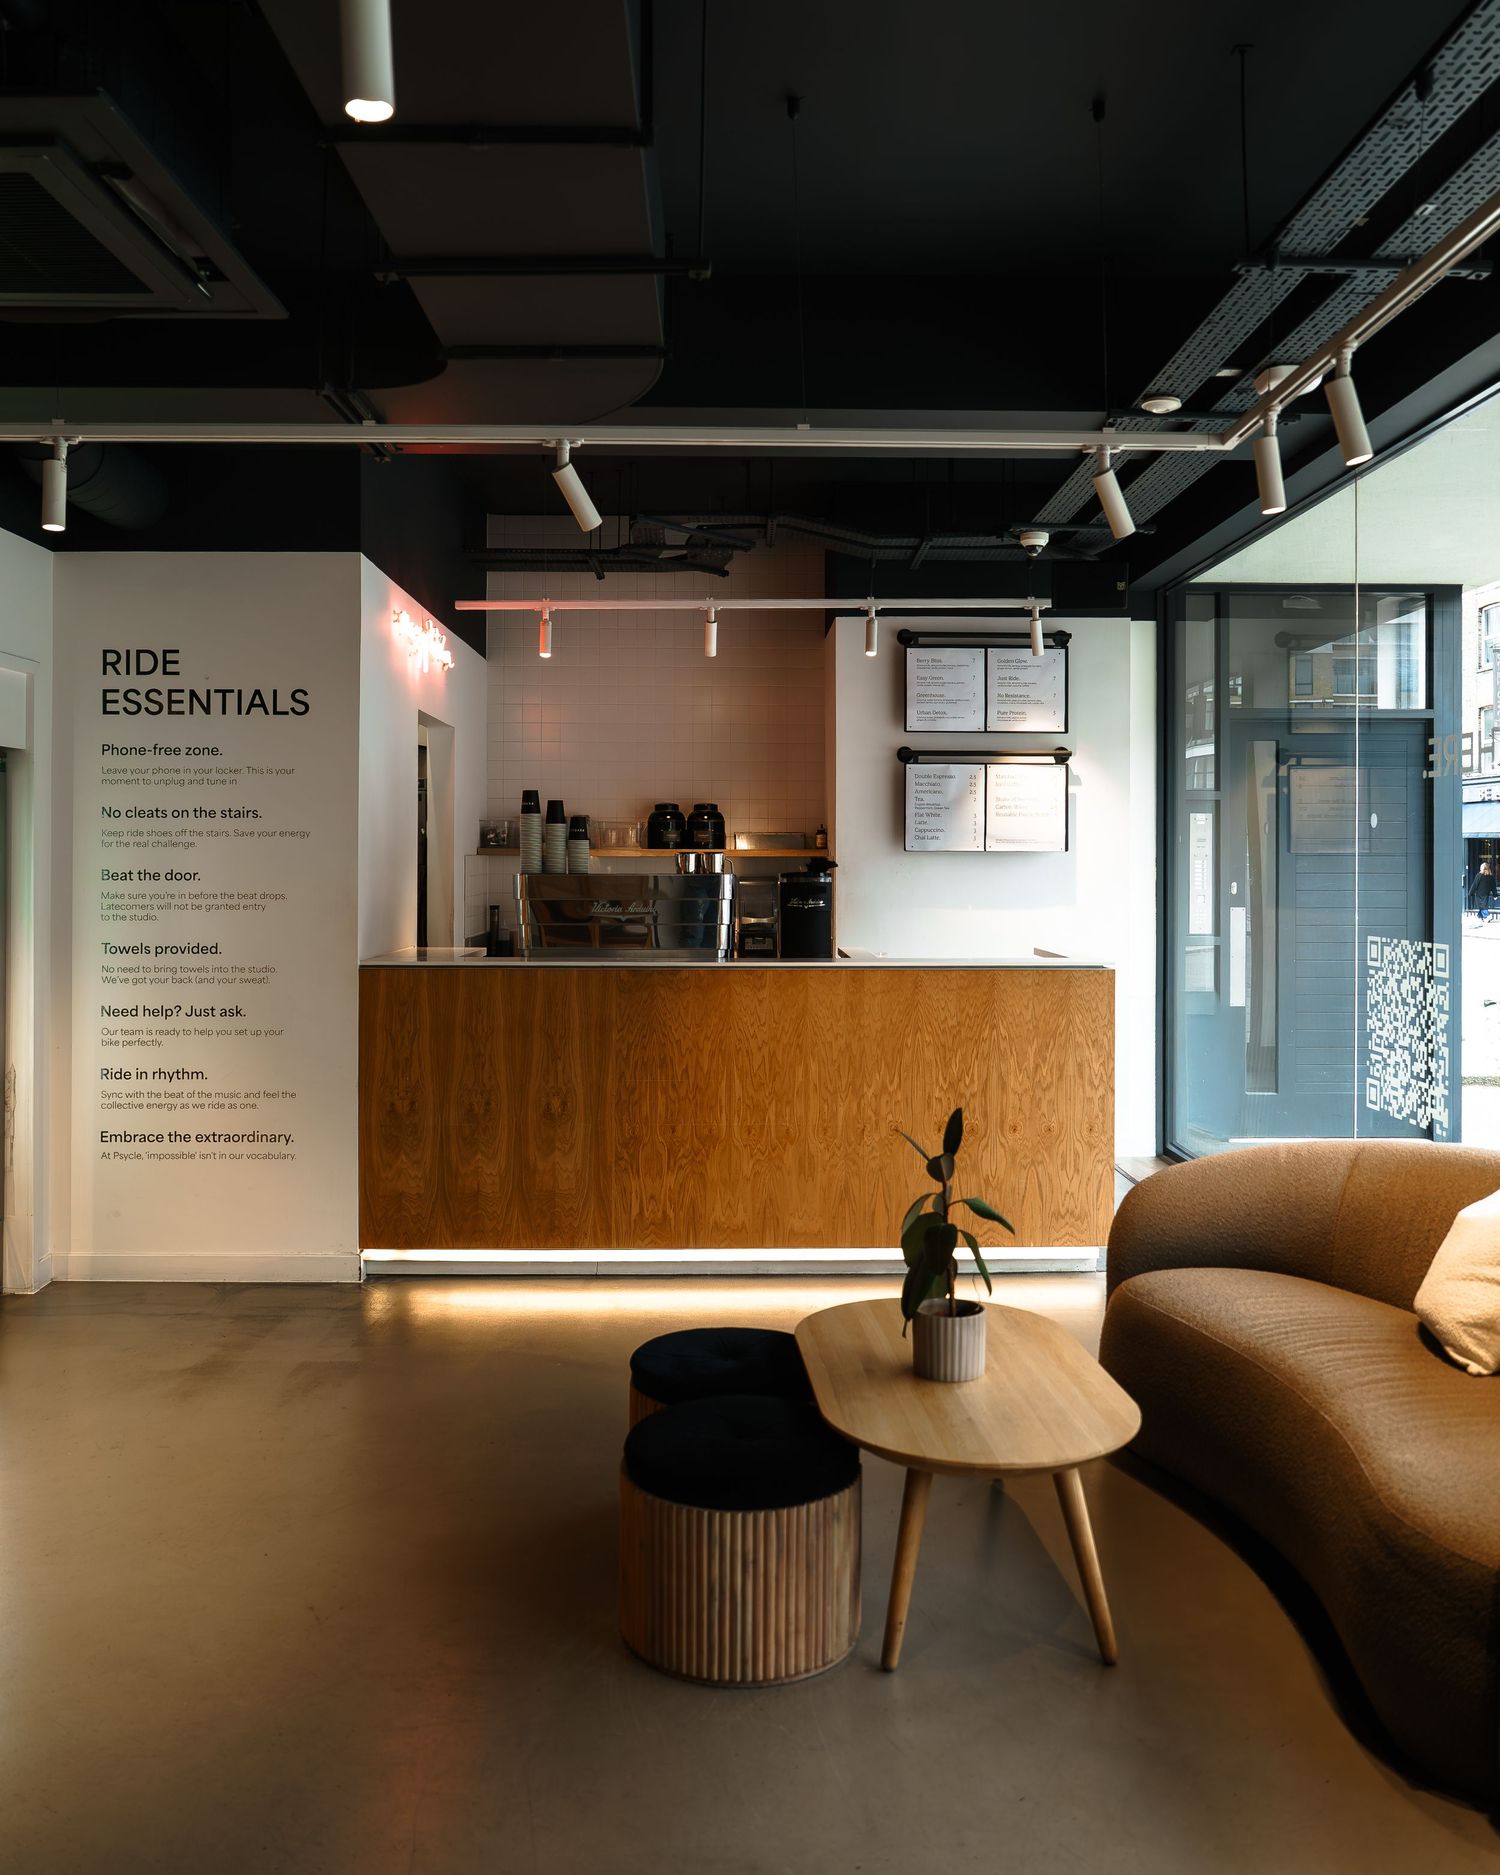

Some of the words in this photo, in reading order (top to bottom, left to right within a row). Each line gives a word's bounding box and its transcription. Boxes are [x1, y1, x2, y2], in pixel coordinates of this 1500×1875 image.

[102, 649, 180, 676] RIDE
[102, 688, 310, 716] ESSENTIALS
[102, 744, 182, 756] Phone-free
[185, 747, 222, 756] zone.
[101, 766, 128, 775] Leave
[129, 768, 150, 776] your
[152, 766, 181, 776] phone
[183, 766, 191, 775] in
[193, 768, 213, 776] your
[215, 766, 244, 775] locker.
[246, 766, 265, 775] This
[266, 766, 273, 775] is
[275, 768, 296, 776] your
[101, 777, 140, 785] moment
[142, 777, 152, 785] to
[154, 777, 185, 787] unplug
[187, 777, 205, 785] and
[206, 777, 227, 785] tune
[102, 806, 121, 818] No
[125, 806, 168, 818] cleats
[172, 809, 189, 818] on
[193, 806, 216, 818] the
[220, 806, 262, 818] stairs.
[101, 828, 125, 839] Keep
[126, 828, 144, 837] ride
[146, 828, 173, 837] shoes
[174, 828, 188, 837] off
[189, 828, 204, 837] the
[205, 828, 232, 837] stairs.
[233, 828, 255, 837] Save
[256, 830, 278, 839] your
[278, 830, 310, 839] energy
[101, 840, 114, 848] for
[115, 840, 130, 848] the
[132, 840, 149, 848] real
[151, 840, 198, 850] challenge.
[102, 869, 134, 881] Beat
[137, 869, 160, 881] the
[164, 869, 200, 881] door.
[100, 892, 126, 900] Make
[148, 892, 176, 901] you're
[178, 892, 186, 900] in
[188, 892, 218, 900] before
[219, 892, 235, 900] the
[237, 892, 258, 900] beat
[100, 902, 155, 911] Latecomers
[156, 902, 172, 911] will
[174, 902, 189, 911] not
[190, 902, 203, 911] be
[204, 902, 240, 912] granted
[242, 902, 266, 912] entry
[100, 913, 110, 921] to
[112, 913, 127, 921] the
[128, 913, 160, 921] studio.
[101, 943, 151, 954] Towels
[155, 943, 222, 957] provided.
[101, 965, 115, 973] No
[116, 965, 140, 973] need
[142, 965, 152, 973] to
[153, 965, 178, 975] bring
[179, 965, 210, 973] towels
[211, 965, 229, 973] into
[230, 965, 246, 973] the
[247, 965, 278, 973] studio.
[101, 976, 130, 984] We've
[131, 976, 147, 985] got
[148, 977, 170, 985] your
[171, 976, 192, 984] back
[194, 976, 215, 985] (and
[216, 977, 237, 985] your
[239, 976, 271, 985] sweat).
[101, 1005, 138, 1017] Need
[143, 1005, 181, 1020] help?
[185, 1005, 216, 1017] Just
[220, 1005, 246, 1017] ask.
[101, 1027, 119, 1036] Our
[120, 1027, 144, 1036] team
[146, 1027, 153, 1036] is
[155, 1027, 181, 1038] ready
[182, 1027, 192, 1036] to
[193, 1027, 214, 1038] help
[215, 1029, 232, 1038] you
[234, 1027, 248, 1036] set
[250, 1029, 262, 1038] up
[263, 1029, 284, 1038] your
[101, 1038, 120, 1047] bike
[122, 1038, 164, 1048] perfectly.
[100, 1068, 132, 1080] Ride
[136, 1068, 148, 1080] in
[152, 1068, 208, 1083] rhythm.
[101, 1090, 123, 1100] Sync
[124, 1090, 144, 1099] with
[146, 1090, 162, 1099] the
[164, 1090, 184, 1099] beat
[186, 1090, 196, 1099] of
[197, 1090, 212, 1099] the
[214, 1090, 241, 1099] music
[243, 1090, 261, 1099] and
[262, 1090, 280, 1099] feel
[281, 1090, 297, 1099] the
[100, 1101, 144, 1110] collective
[146, 1102, 178, 1111] energy
[207, 1101, 226, 1110] ride
[100, 1131, 164, 1142] Embrace
[168, 1131, 192, 1142] the
[195, 1131, 294, 1146] extraordinary.
[100, 1151, 111, 1160] At
[113, 1151, 144, 1161] Psycle,
[199, 1151, 216, 1160] isn't
[218, 1151, 226, 1160] in
[246, 1151, 297, 1161] vocabulary.
